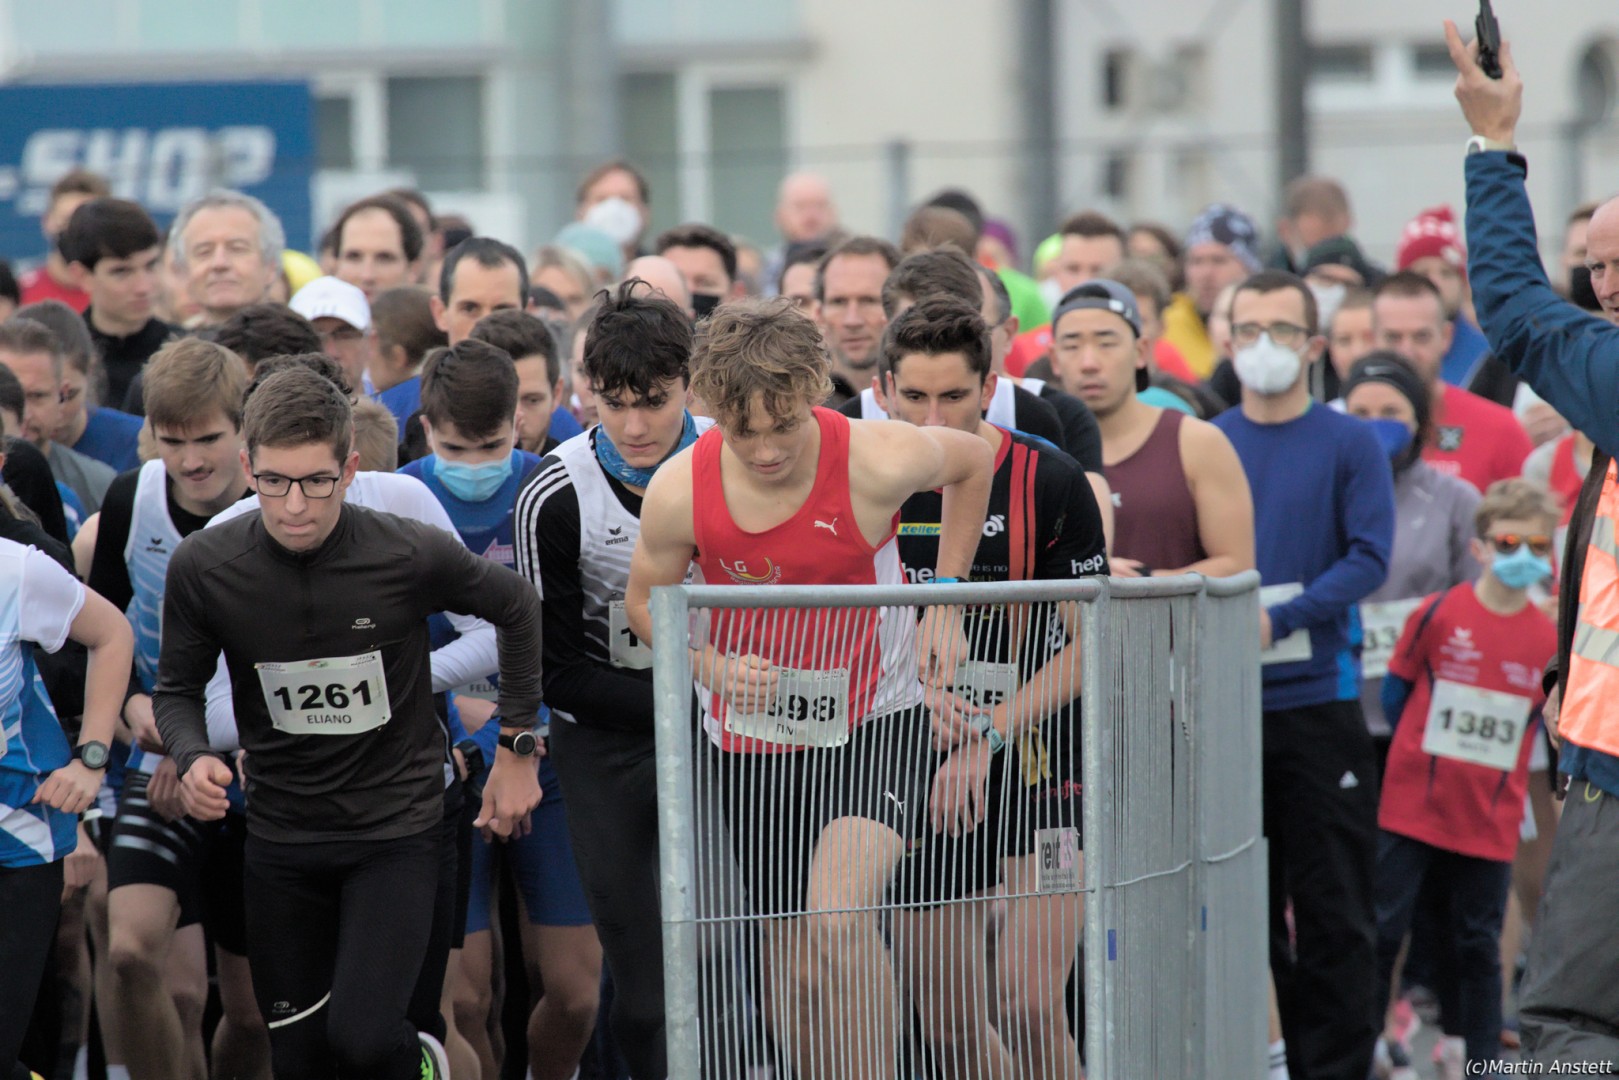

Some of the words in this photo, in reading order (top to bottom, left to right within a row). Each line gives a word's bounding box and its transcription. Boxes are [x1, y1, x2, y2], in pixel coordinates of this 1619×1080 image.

[901, 525, 941, 534] Keller
[605, 536, 629, 546] erima
[1071, 554, 1104, 575] hep
[274, 680, 372, 711] 1261
[307, 714, 352, 724] ELIANO
[1440, 707, 1515, 744] 1383
